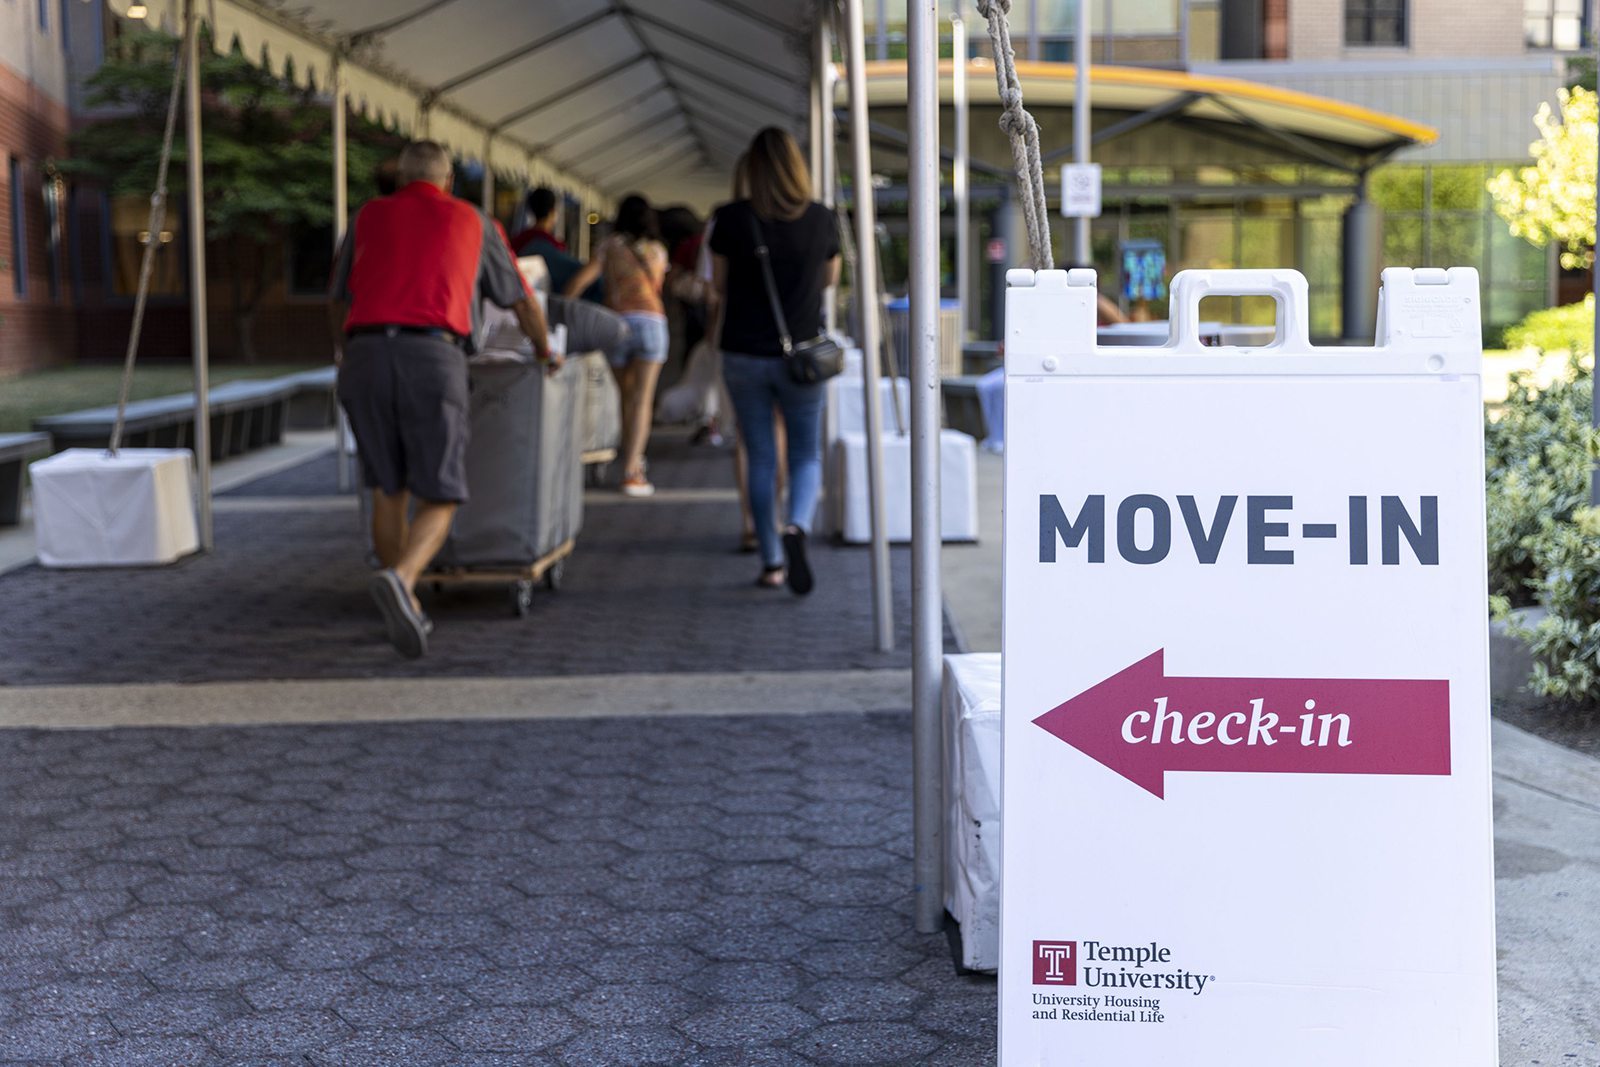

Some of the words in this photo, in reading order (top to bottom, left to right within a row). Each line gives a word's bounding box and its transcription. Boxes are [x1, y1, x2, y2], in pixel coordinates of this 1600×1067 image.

[1038, 493, 1440, 566] MOVE-IN
[1121, 696, 1353, 748] check-in
[1083, 941, 1171, 968] Temple
[1032, 993, 1100, 1009] University
[1104, 995, 1160, 1011] Housing
[1032, 1008, 1057, 1020] and
[1062, 1009, 1136, 1022] Residential
[1139, 1011, 1165, 1023] Life
